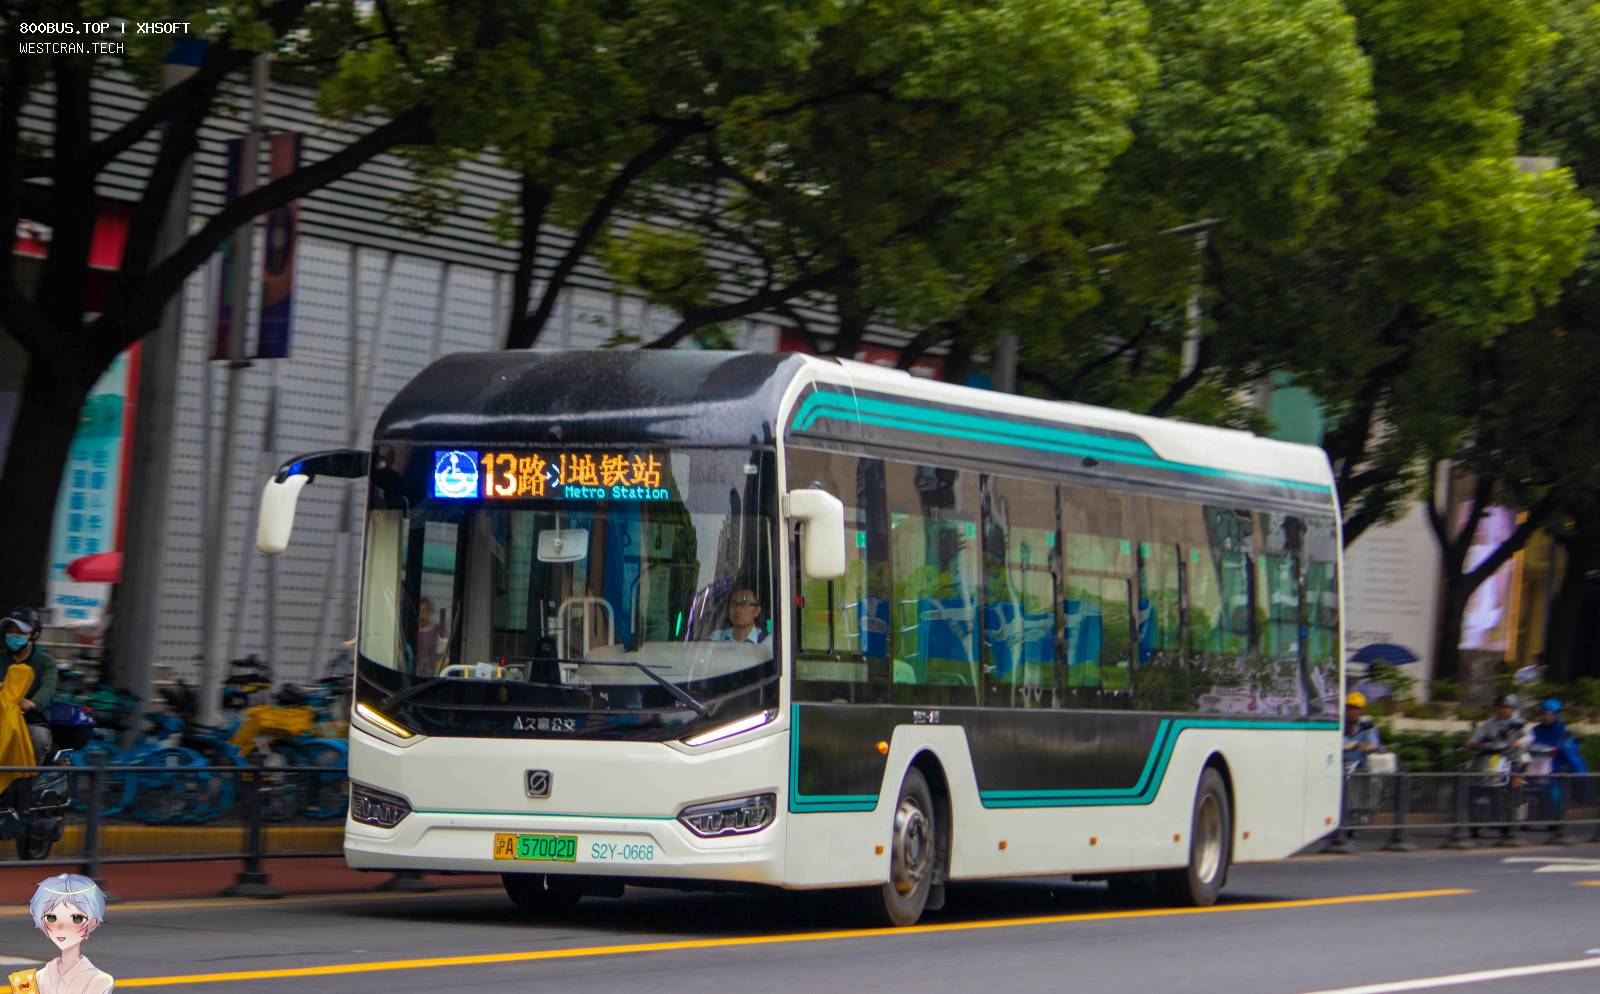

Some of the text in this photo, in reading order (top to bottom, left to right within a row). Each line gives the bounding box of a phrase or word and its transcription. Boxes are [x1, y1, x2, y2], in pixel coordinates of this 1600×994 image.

[480, 453, 661, 496] 13路 地铁站
[565, 485, 668, 500] Metro Station
[591, 843, 654, 860] S2Y-0668
